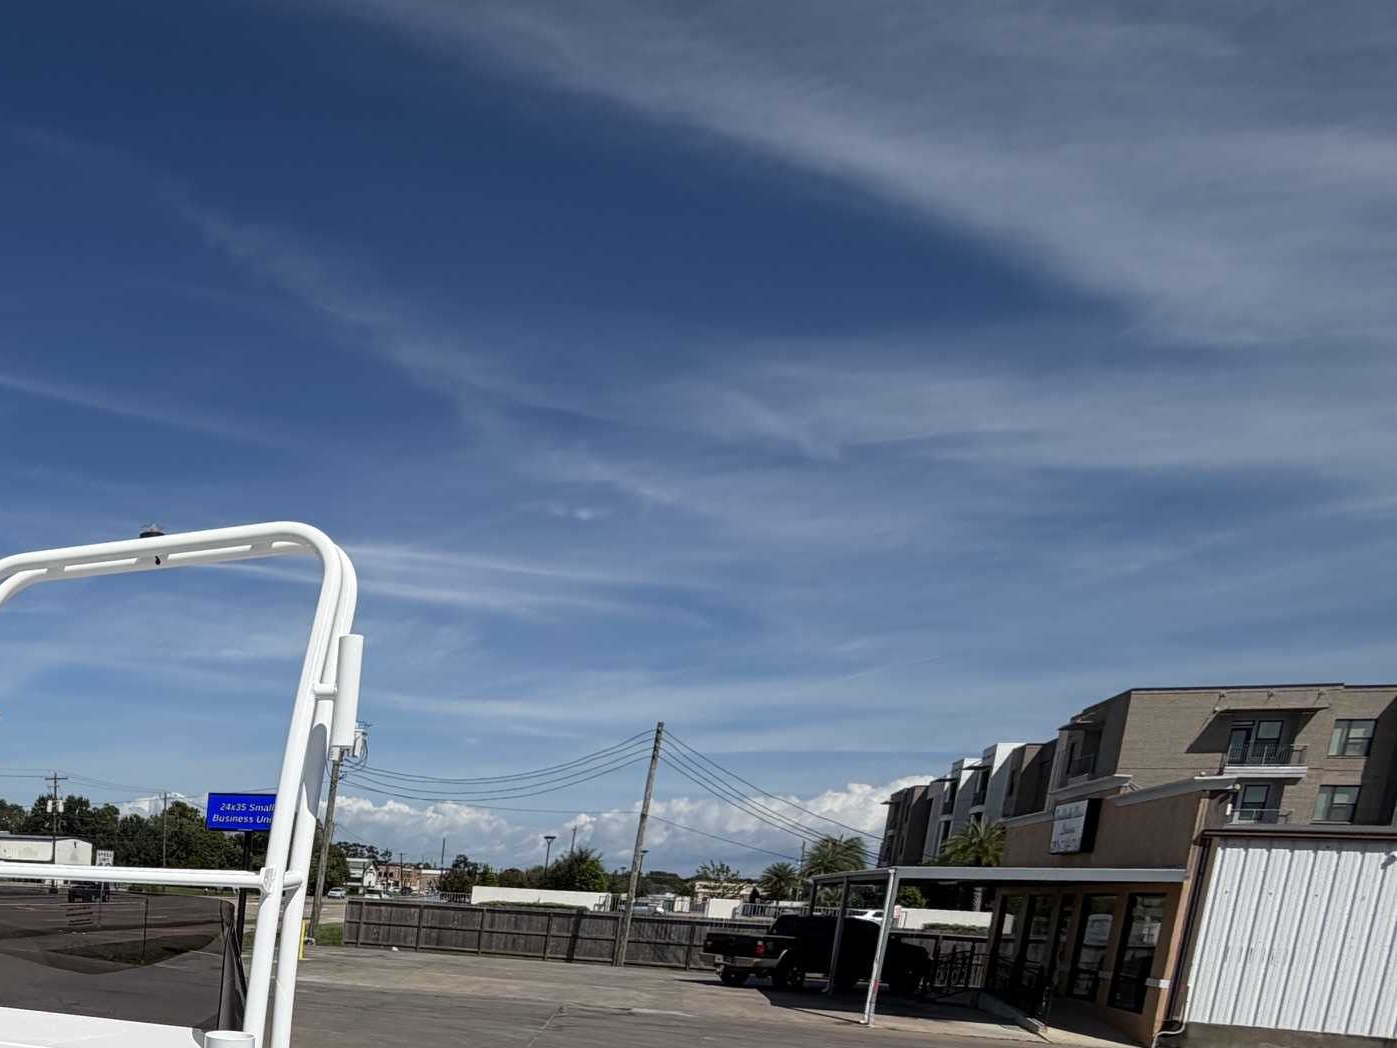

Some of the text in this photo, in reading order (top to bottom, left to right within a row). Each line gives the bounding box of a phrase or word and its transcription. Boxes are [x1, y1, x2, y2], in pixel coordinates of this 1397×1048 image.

[219, 802, 275, 813] 24x35 Small
[212, 813, 274, 824] Business Uni
